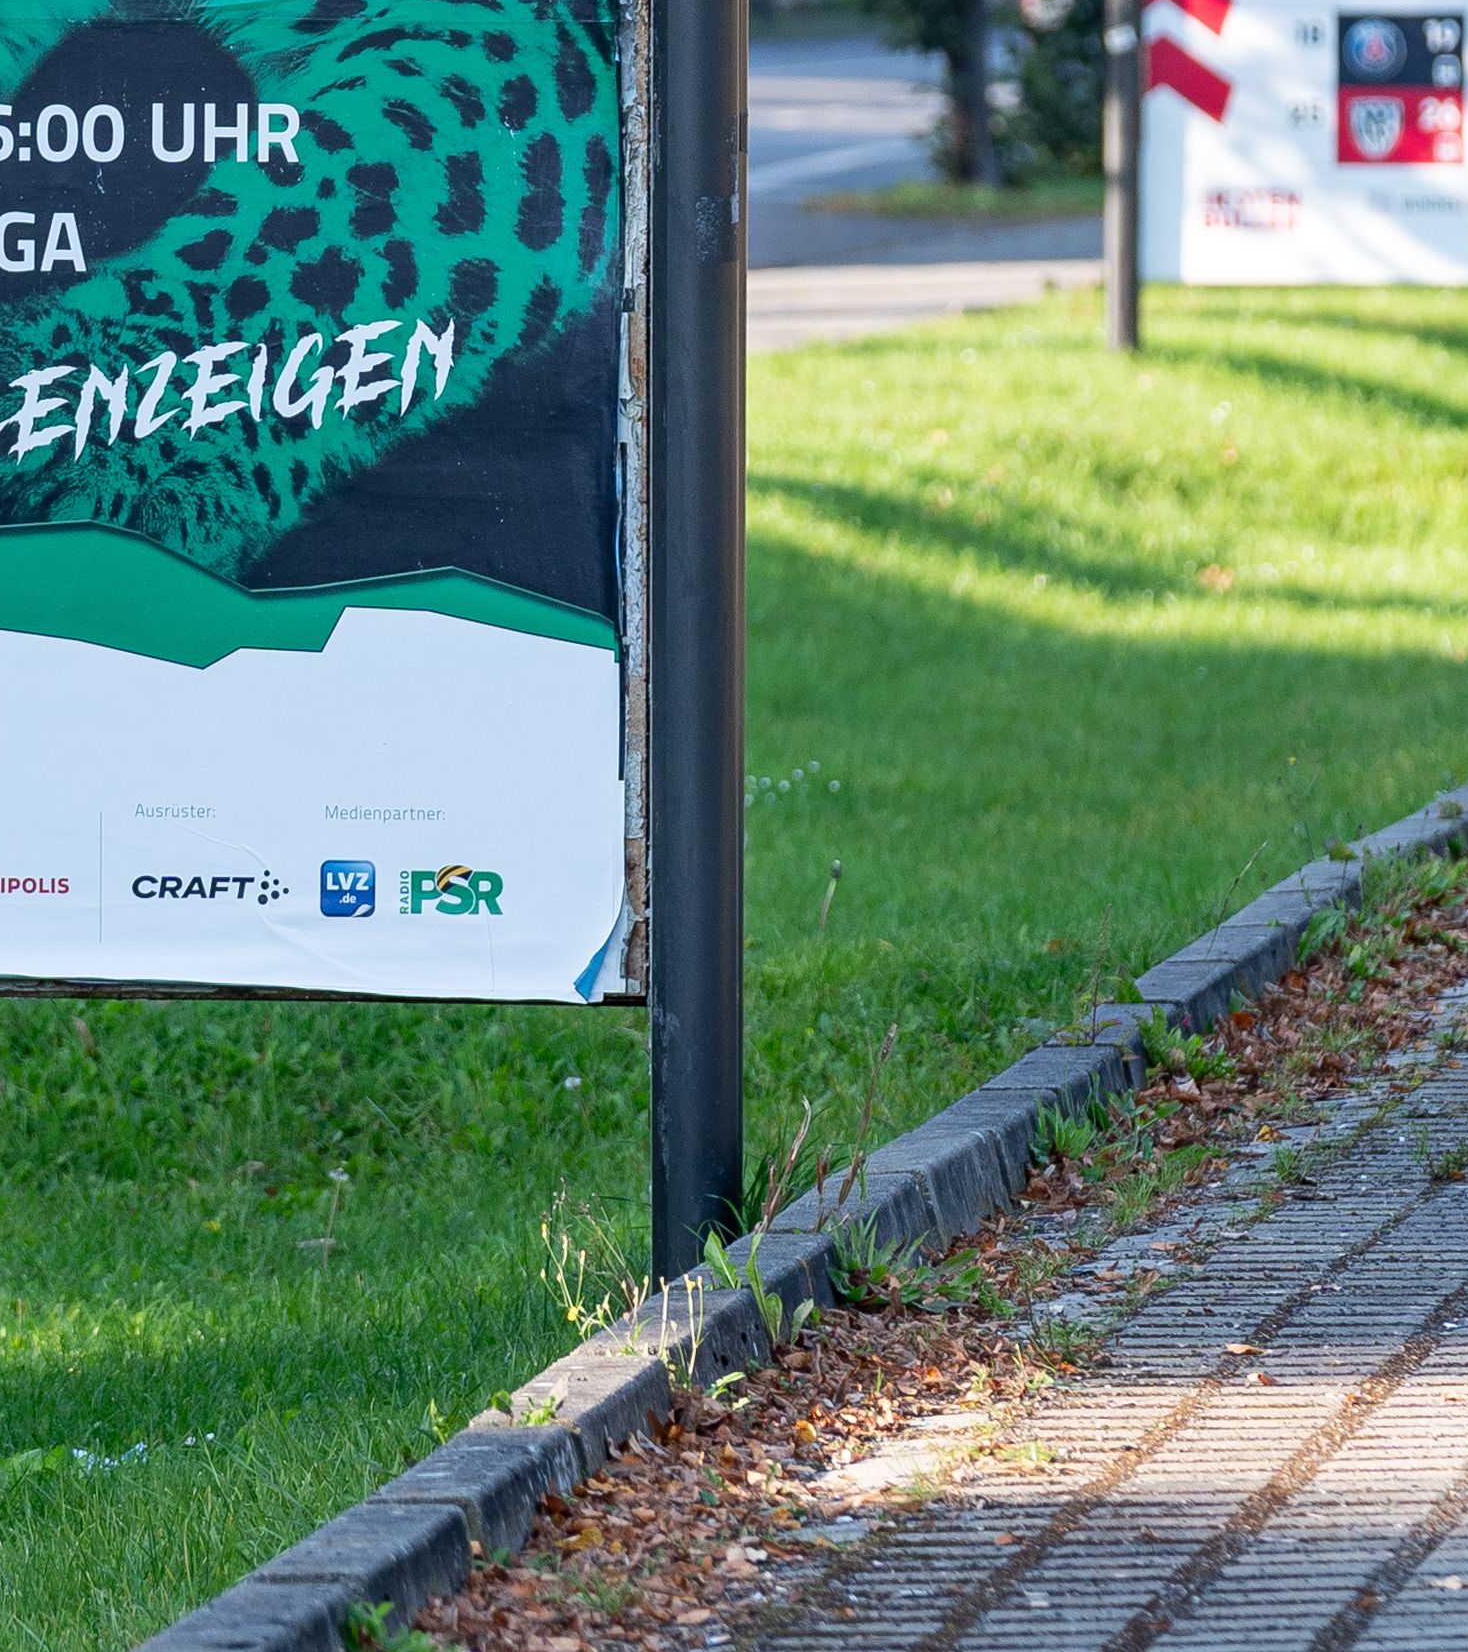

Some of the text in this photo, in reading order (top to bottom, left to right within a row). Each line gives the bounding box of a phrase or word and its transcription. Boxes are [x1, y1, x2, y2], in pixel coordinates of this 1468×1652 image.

[1422, 19, 1460, 52] 19
[1418, 97, 1460, 133] 26
[152, 103, 299, 162] UHR
[134, 803, 216, 819] Ausrüster:
[325, 804, 446, 824] Medienpartner:
[131, 875, 255, 900] CRAFT
[326, 872, 370, 891] LVZ
[399, 870, 410, 915] RADIO
[411, 864, 503, 915] PSR
[339, 893, 357, 904] .de
